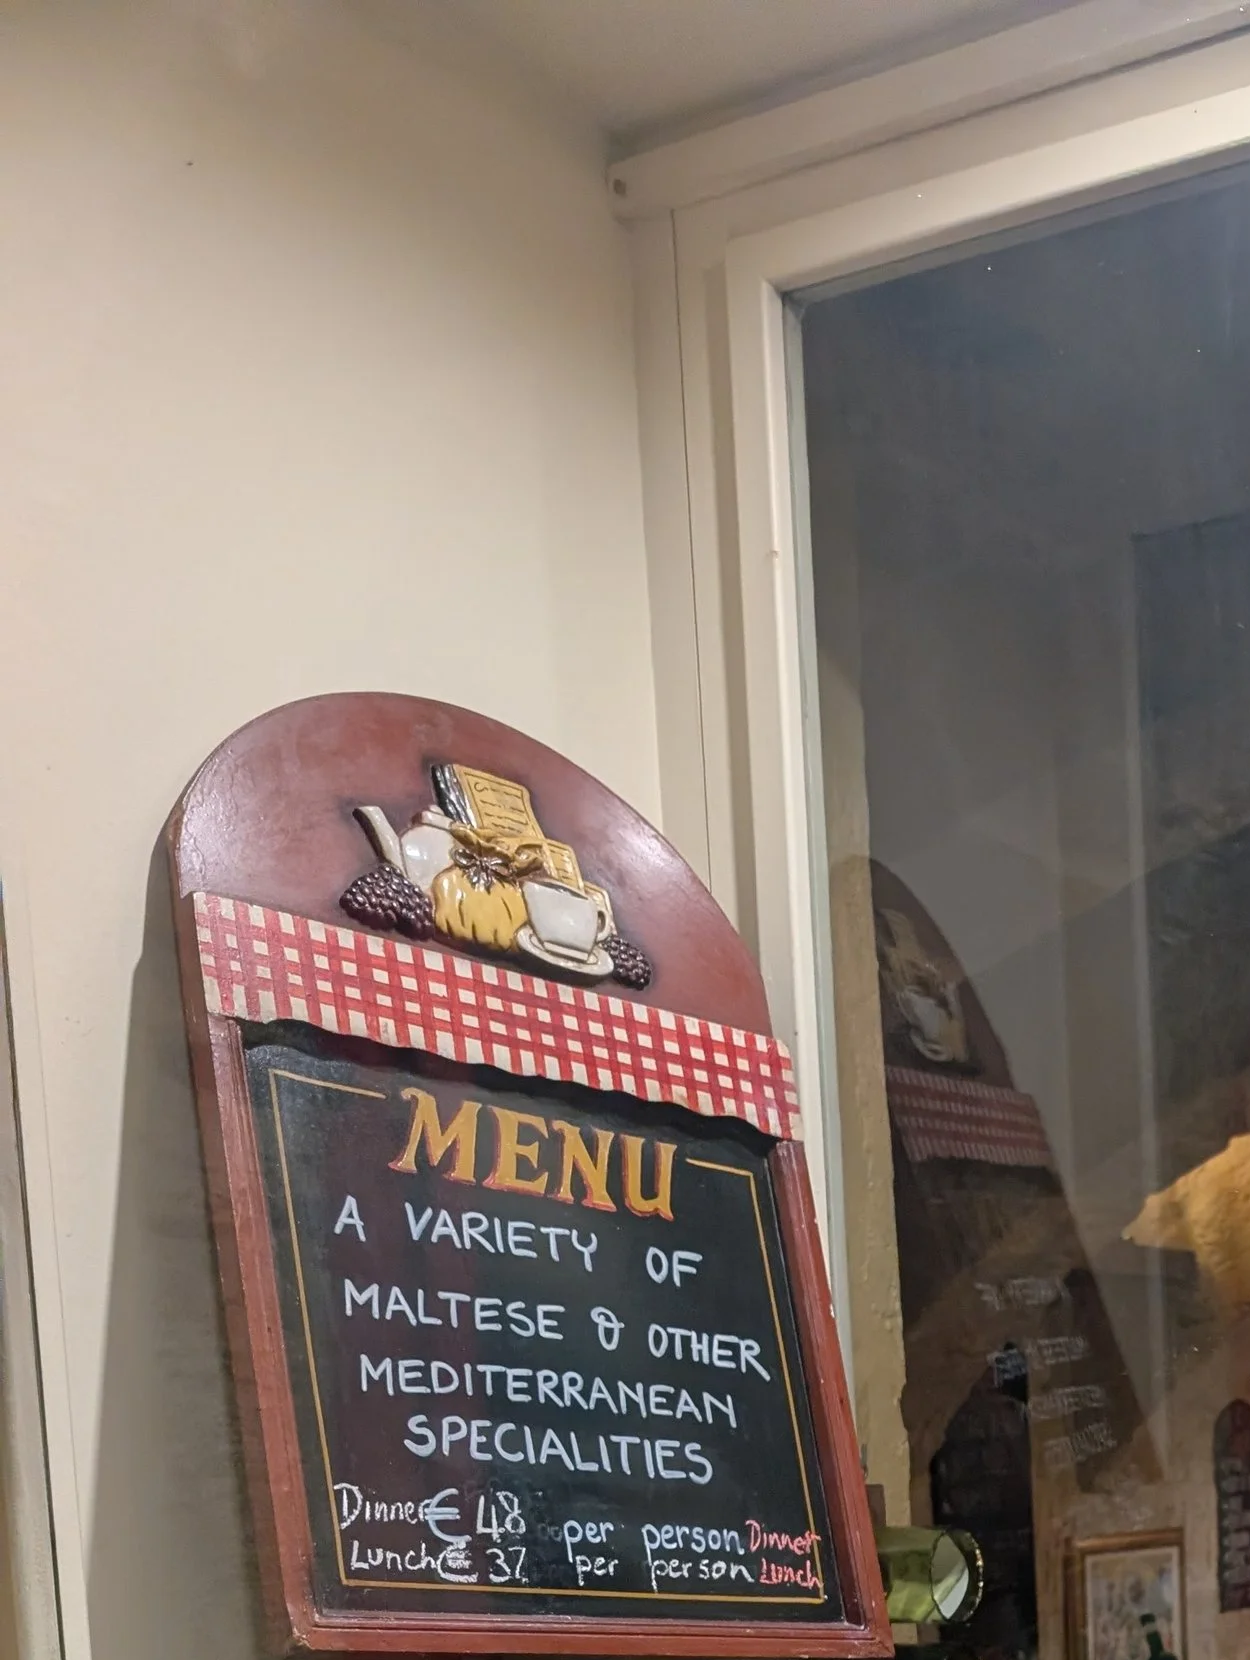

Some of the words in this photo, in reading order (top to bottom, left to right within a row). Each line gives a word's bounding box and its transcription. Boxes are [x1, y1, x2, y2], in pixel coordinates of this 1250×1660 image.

[388, 1087, 677, 1222] MENU
[334, 1195, 366, 1242] A
[405, 1201, 598, 1273] VARIETY
[646, 1245, 703, 1288] OF
[344, 1279, 565, 1341] MALTESE
[648, 1325, 771, 1381] OTHER
[360, 1354, 738, 1428] MEDITERRANEAN
[404, 1415, 714, 1486] SPECIALITIES
[564, 1519, 614, 1563] per
[641, 1522, 745, 1568] person
[745, 1519, 821, 1555] Dinner
[575, 1555, 619, 1587] per
[649, 1558, 755, 1593] person
[759, 1557, 824, 1590] Lunch
